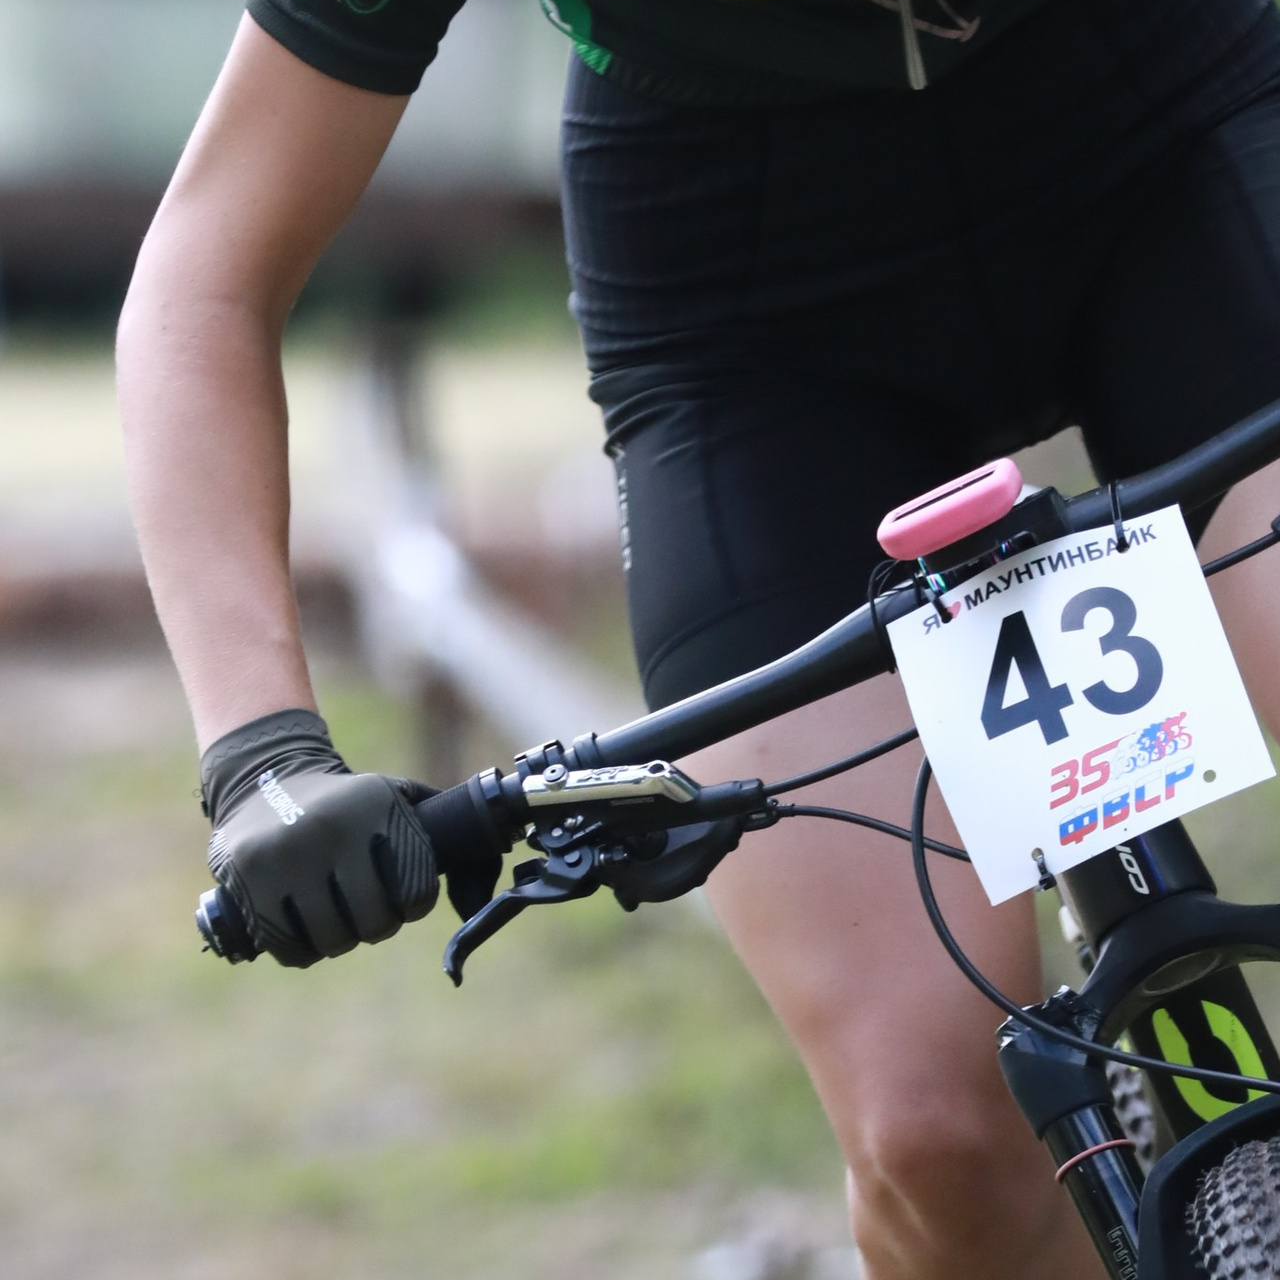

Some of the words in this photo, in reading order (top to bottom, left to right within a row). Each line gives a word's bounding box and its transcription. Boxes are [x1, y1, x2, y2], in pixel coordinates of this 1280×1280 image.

[922, 613, 942, 635] Я
[964, 524, 1158, 611] МАУНТИНБАЙК
[981, 586, 1164, 746] 43
